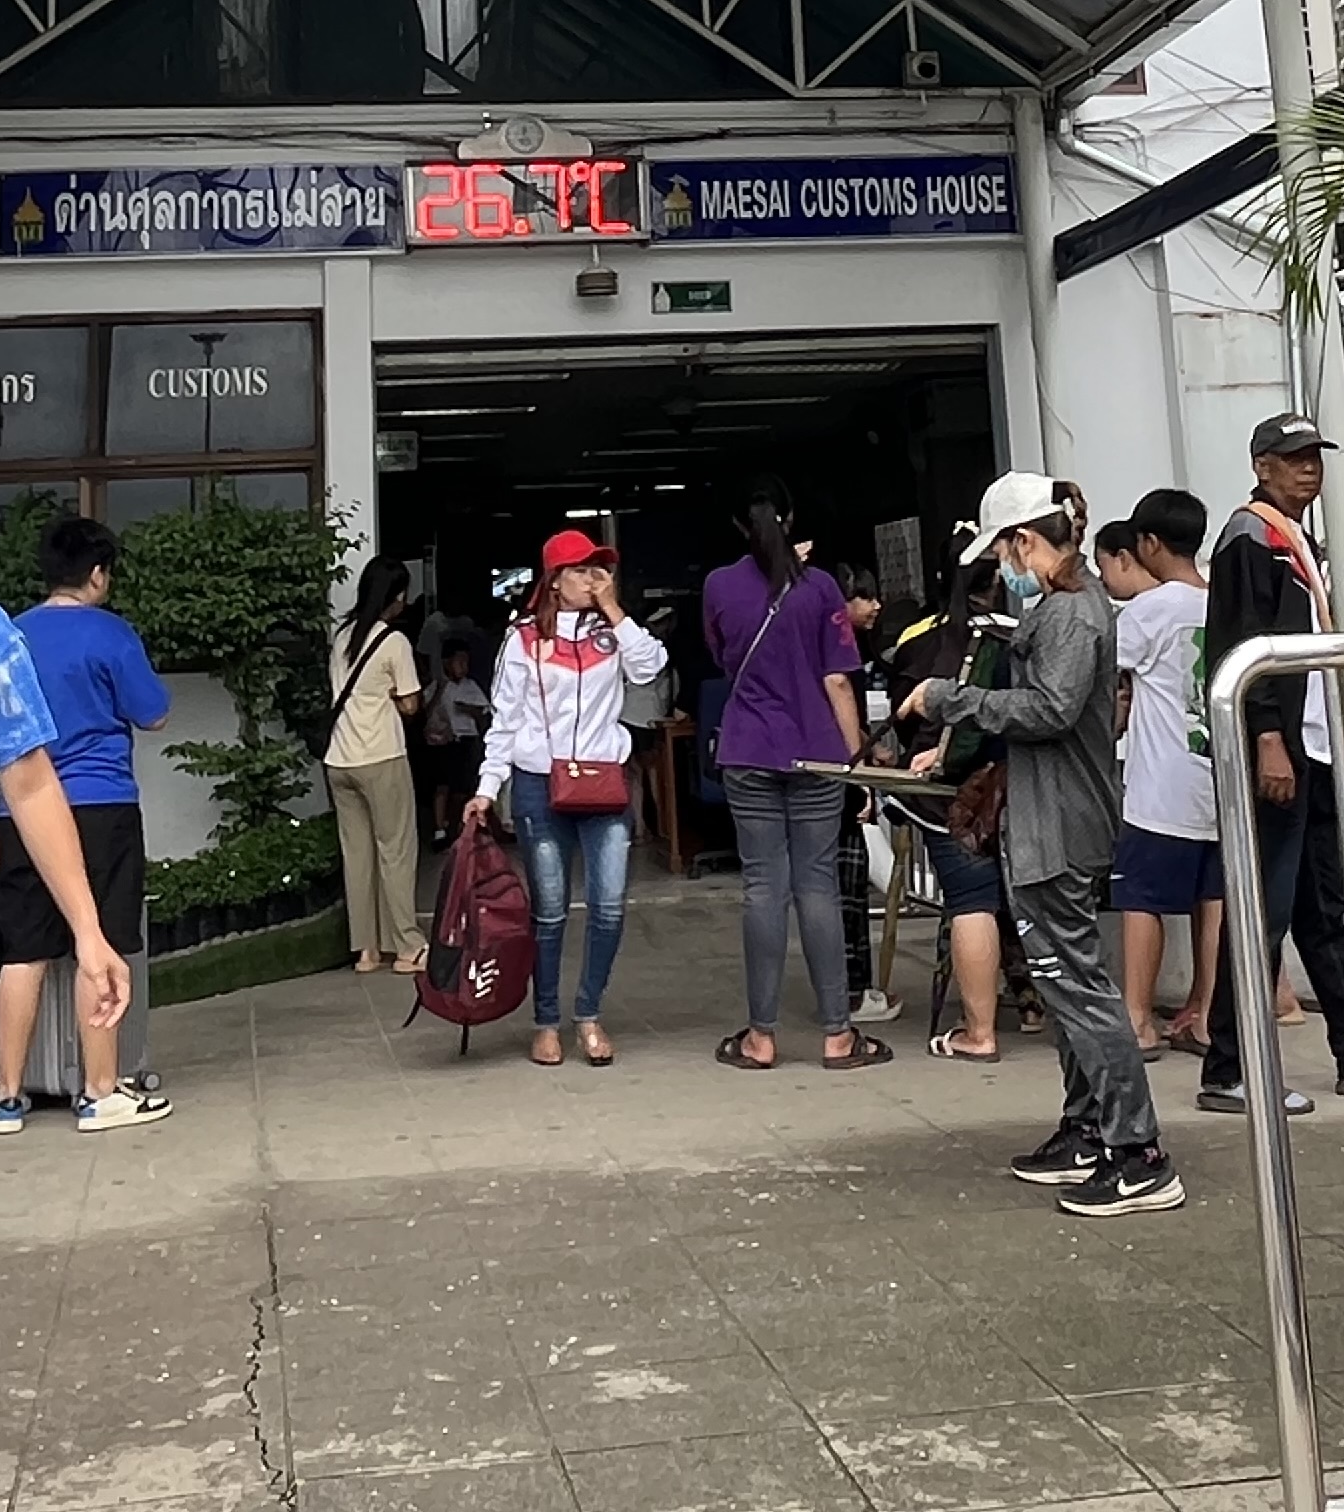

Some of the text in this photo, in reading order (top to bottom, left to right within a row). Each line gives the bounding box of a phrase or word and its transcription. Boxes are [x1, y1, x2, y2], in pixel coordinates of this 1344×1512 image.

[55, 169, 386, 250] ด่านศุลกากรแม่สาย
[700, 174, 1008, 220] MAESAI CUSTOMS HOUSE
[148, 366, 269, 399] CUSTOMS
